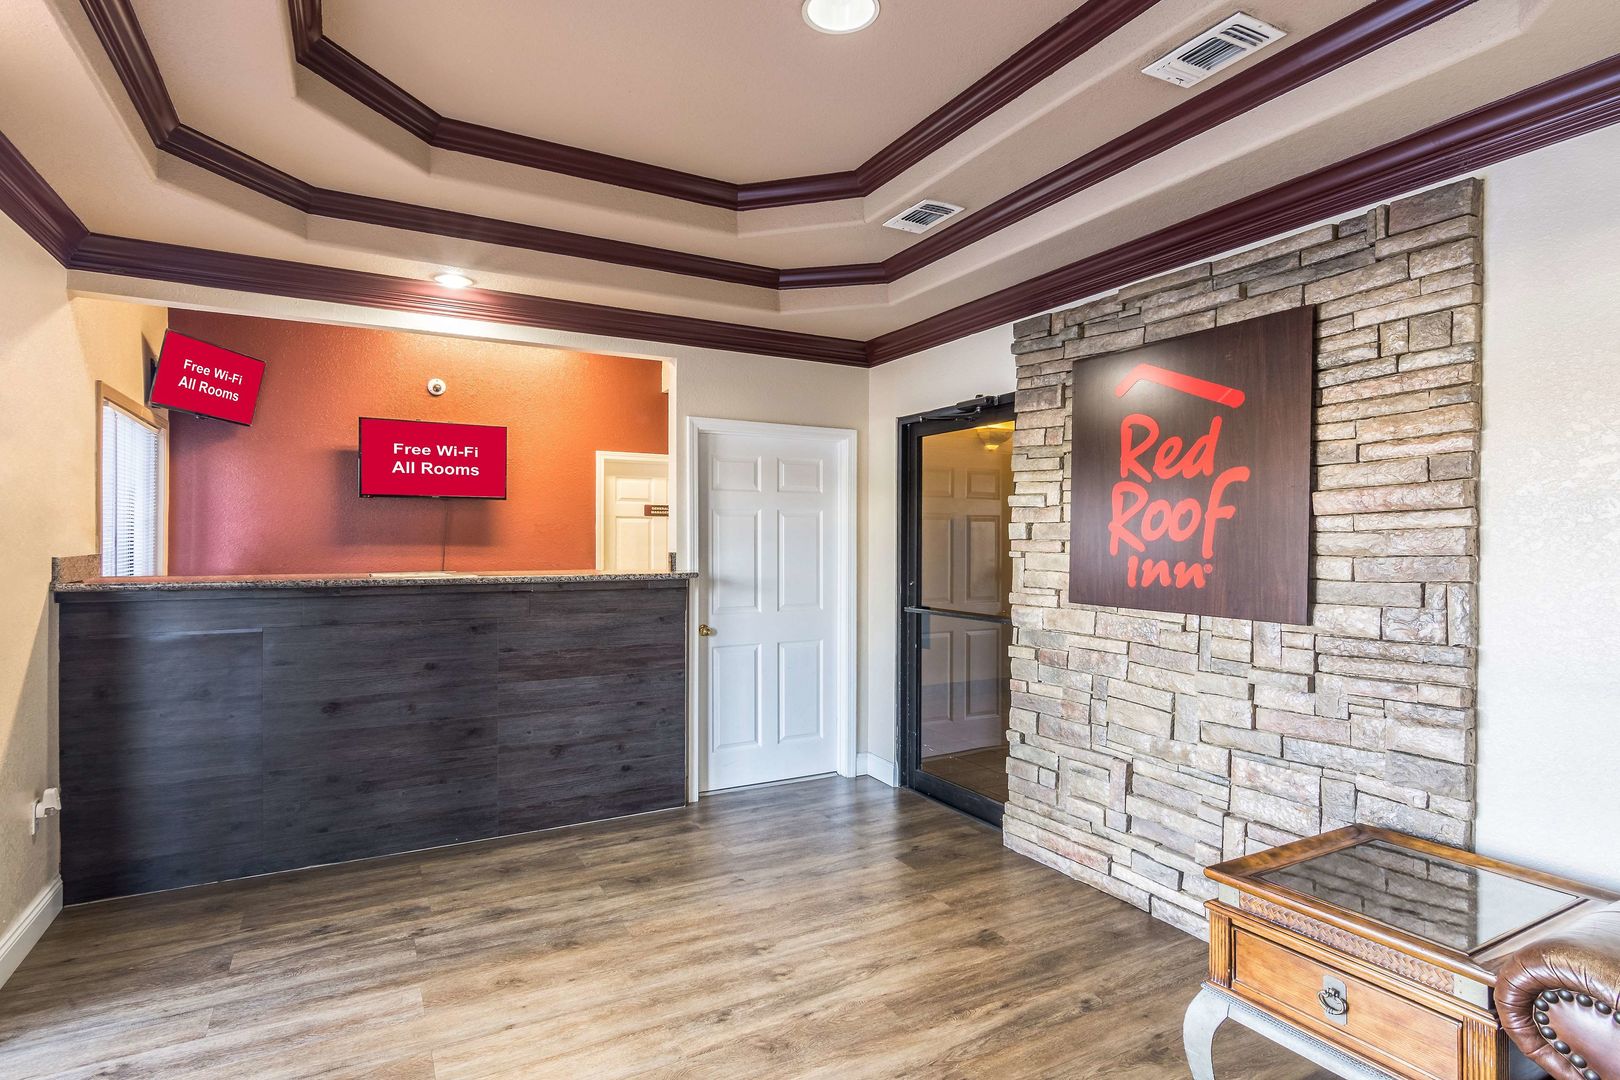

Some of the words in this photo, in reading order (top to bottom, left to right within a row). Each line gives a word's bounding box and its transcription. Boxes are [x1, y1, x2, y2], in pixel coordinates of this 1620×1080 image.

[183, 358, 211, 376] Free
[214, 367, 243, 385] Wi-Fi
[178, 376, 197, 391] All
[198, 380, 239, 402] Rooms
[393, 442, 432, 456] Free
[436, 444, 479, 458] Wi-Fi
[1120, 413, 1223, 483] Red
[391, 460, 415, 474] All
[421, 461, 480, 476] Rooms
[1108, 466, 1251, 559] Roof
